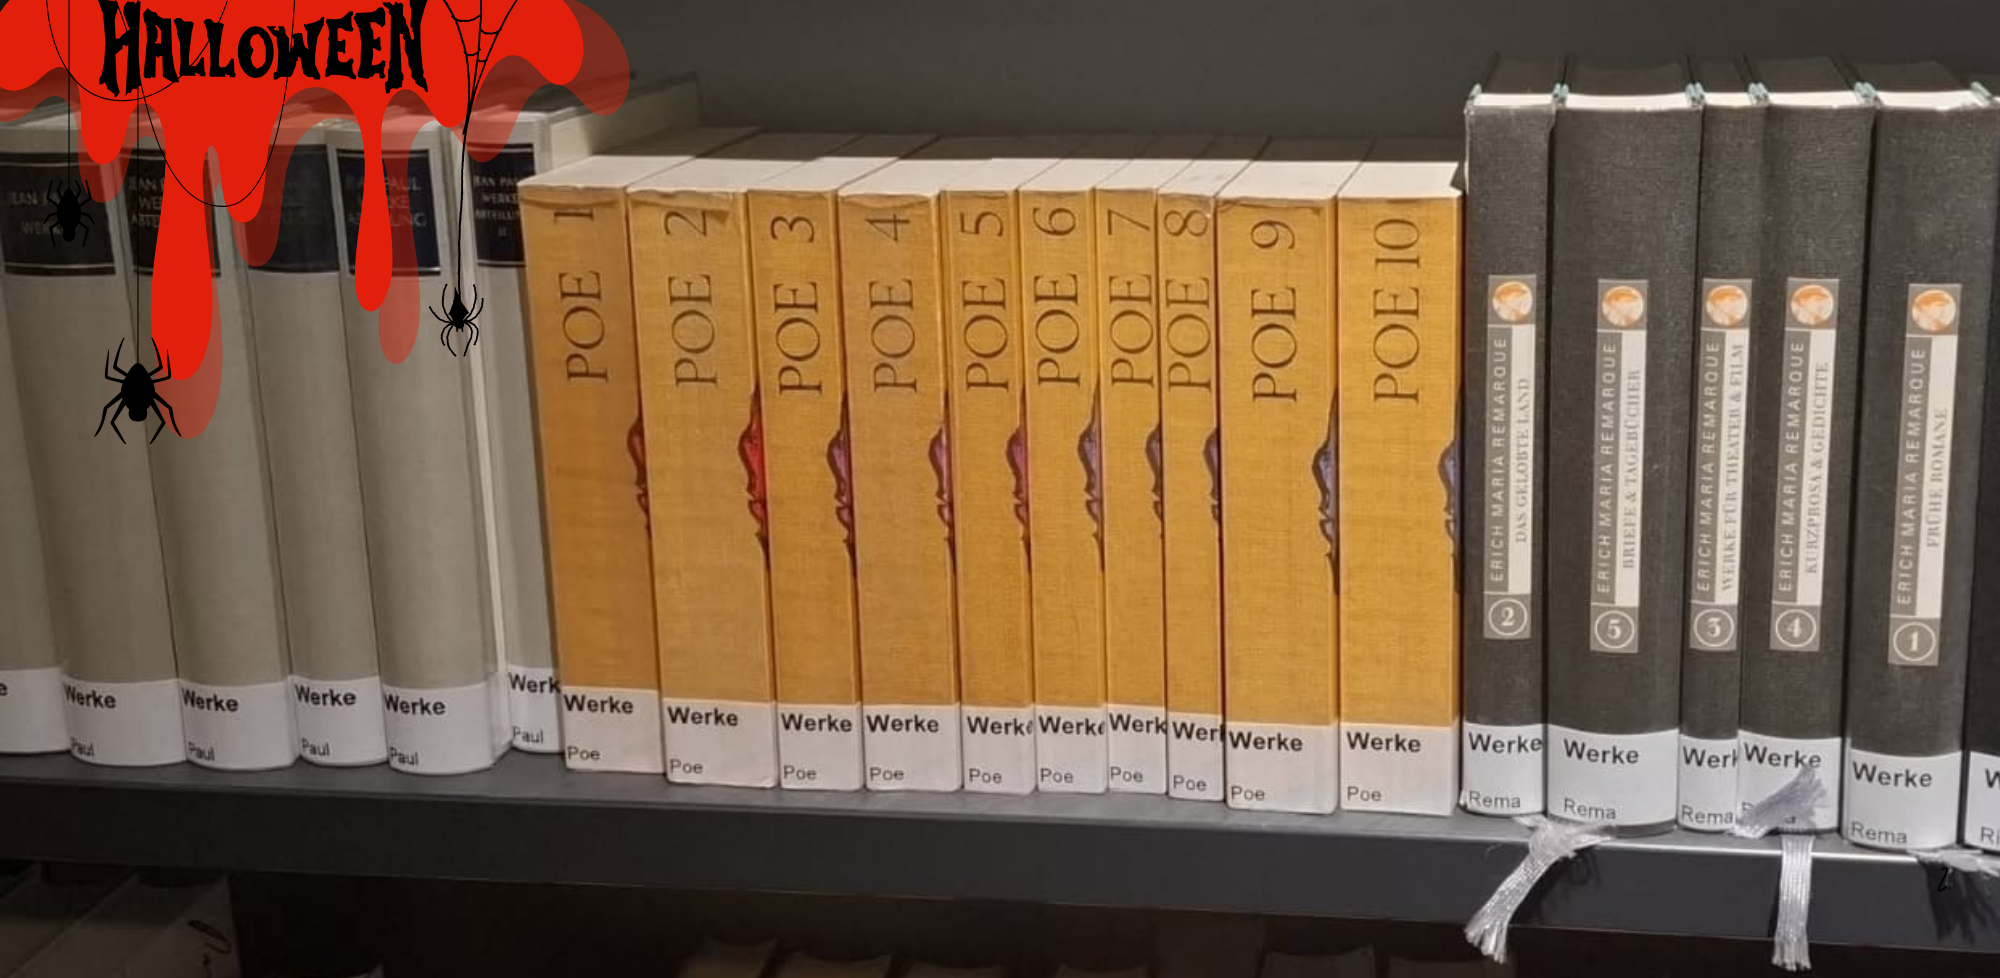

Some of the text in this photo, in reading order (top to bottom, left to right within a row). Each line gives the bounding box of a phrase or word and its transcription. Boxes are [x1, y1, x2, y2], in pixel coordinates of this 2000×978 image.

[554, 209, 609, 383] POE 1
[664, 210, 718, 387] POE 2
[771, 216, 823, 395] POE 3
[865, 214, 917, 393] POE 4
[960, 211, 1009, 393] POE 5
[1033, 207, 1081, 388] POE 6
[1107, 209, 1154, 388] POE 7
[1163, 210, 1212, 391] POE 8
[1251, 220, 1297, 402] POE 9
[1373, 218, 1420, 402] POE 10
[1517, 377, 1530, 424] LAND
[1930, 407, 1948, 483] ROMANE
[1490, 338, 1508, 582] ERICH MARIA REMARQUE
[1597, 343, 1616, 593] ERICH MARIA REMARQUE
[1697, 341, 1720, 592] ERICH MARIA REMARQUE
[1778, 341, 1804, 592] ERICH MARIA REMARQUE
[1897, 348, 1926, 605] ERICH MARIA REMARQUE
[1515, 512, 1528, 543] DAS
[1721, 528, 1737, 591] WERKE
[1501, 607, 1515, 626] 2
[1707, 617, 1721, 637] 3
[1607, 618, 1622, 639] 5
[1787, 617, 1801, 638] 4
[1909, 631, 1919, 651] 1
[64, 684, 117, 709] Werke
[182, 688, 239, 712] Werke
[295, 684, 356, 707] Werke
[384, 694, 446, 715] Werke
[563, 694, 634, 714] Werke
[668, 706, 739, 727] Werke
[781, 713, 852, 733] Werke
[866, 714, 940, 733] Werke
[512, 726, 544, 745] Paul
[1229, 731, 1303, 752] Werke
[1347, 732, 1421, 753] Werke
[1468, 732, 1543, 754] Werke
[188, 741, 216, 761] Paul
[301, 738, 331, 757] Paul
[390, 746, 419, 766] Paul
[567, 746, 601, 762] Poe
[1564, 738, 1640, 765] Werke
[1743, 742, 1822, 770] Werke
[669, 759, 703, 774] Poe
[783, 765, 817, 781] Poe
[869, 767, 905, 782] Poe
[968, 768, 1002, 784] Poe
[1040, 768, 1074, 784] Poe
[1110, 766, 1144, 783] Poe
[1852, 761, 1933, 788] Werke
[1173, 774, 1207, 792] Poe
[1230, 785, 1265, 801] Poe
[1347, 785, 1382, 802] Poe
[1468, 790, 1521, 809] Rema
[1563, 798, 1617, 820] Rema
[1681, 805, 1733, 825] Rema
[1851, 821, 1908, 844] Rema
